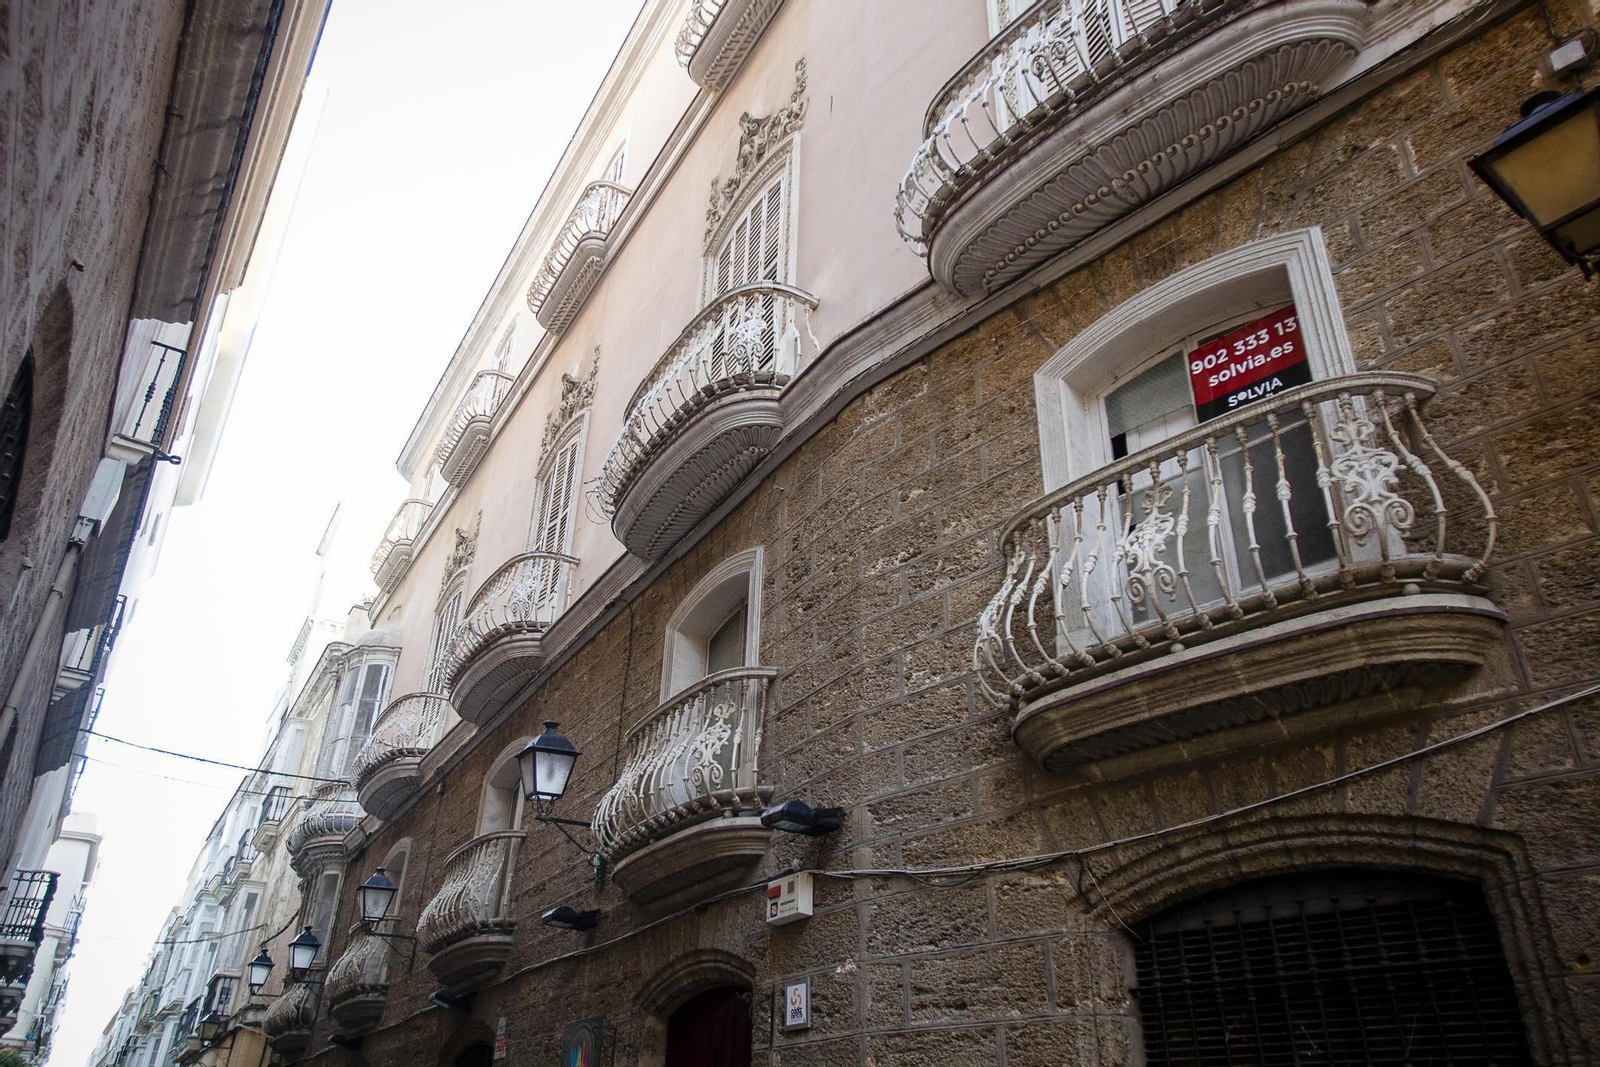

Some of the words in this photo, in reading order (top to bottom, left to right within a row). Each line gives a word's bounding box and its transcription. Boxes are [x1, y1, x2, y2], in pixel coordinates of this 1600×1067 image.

[1191, 348, 1228, 374] 902
[1233, 328, 1269, 355] 333
[1274, 315, 1299, 336] 13
[1209, 341, 1294, 387] solvia.es
[1228, 377, 1283, 407] SOLVIA
